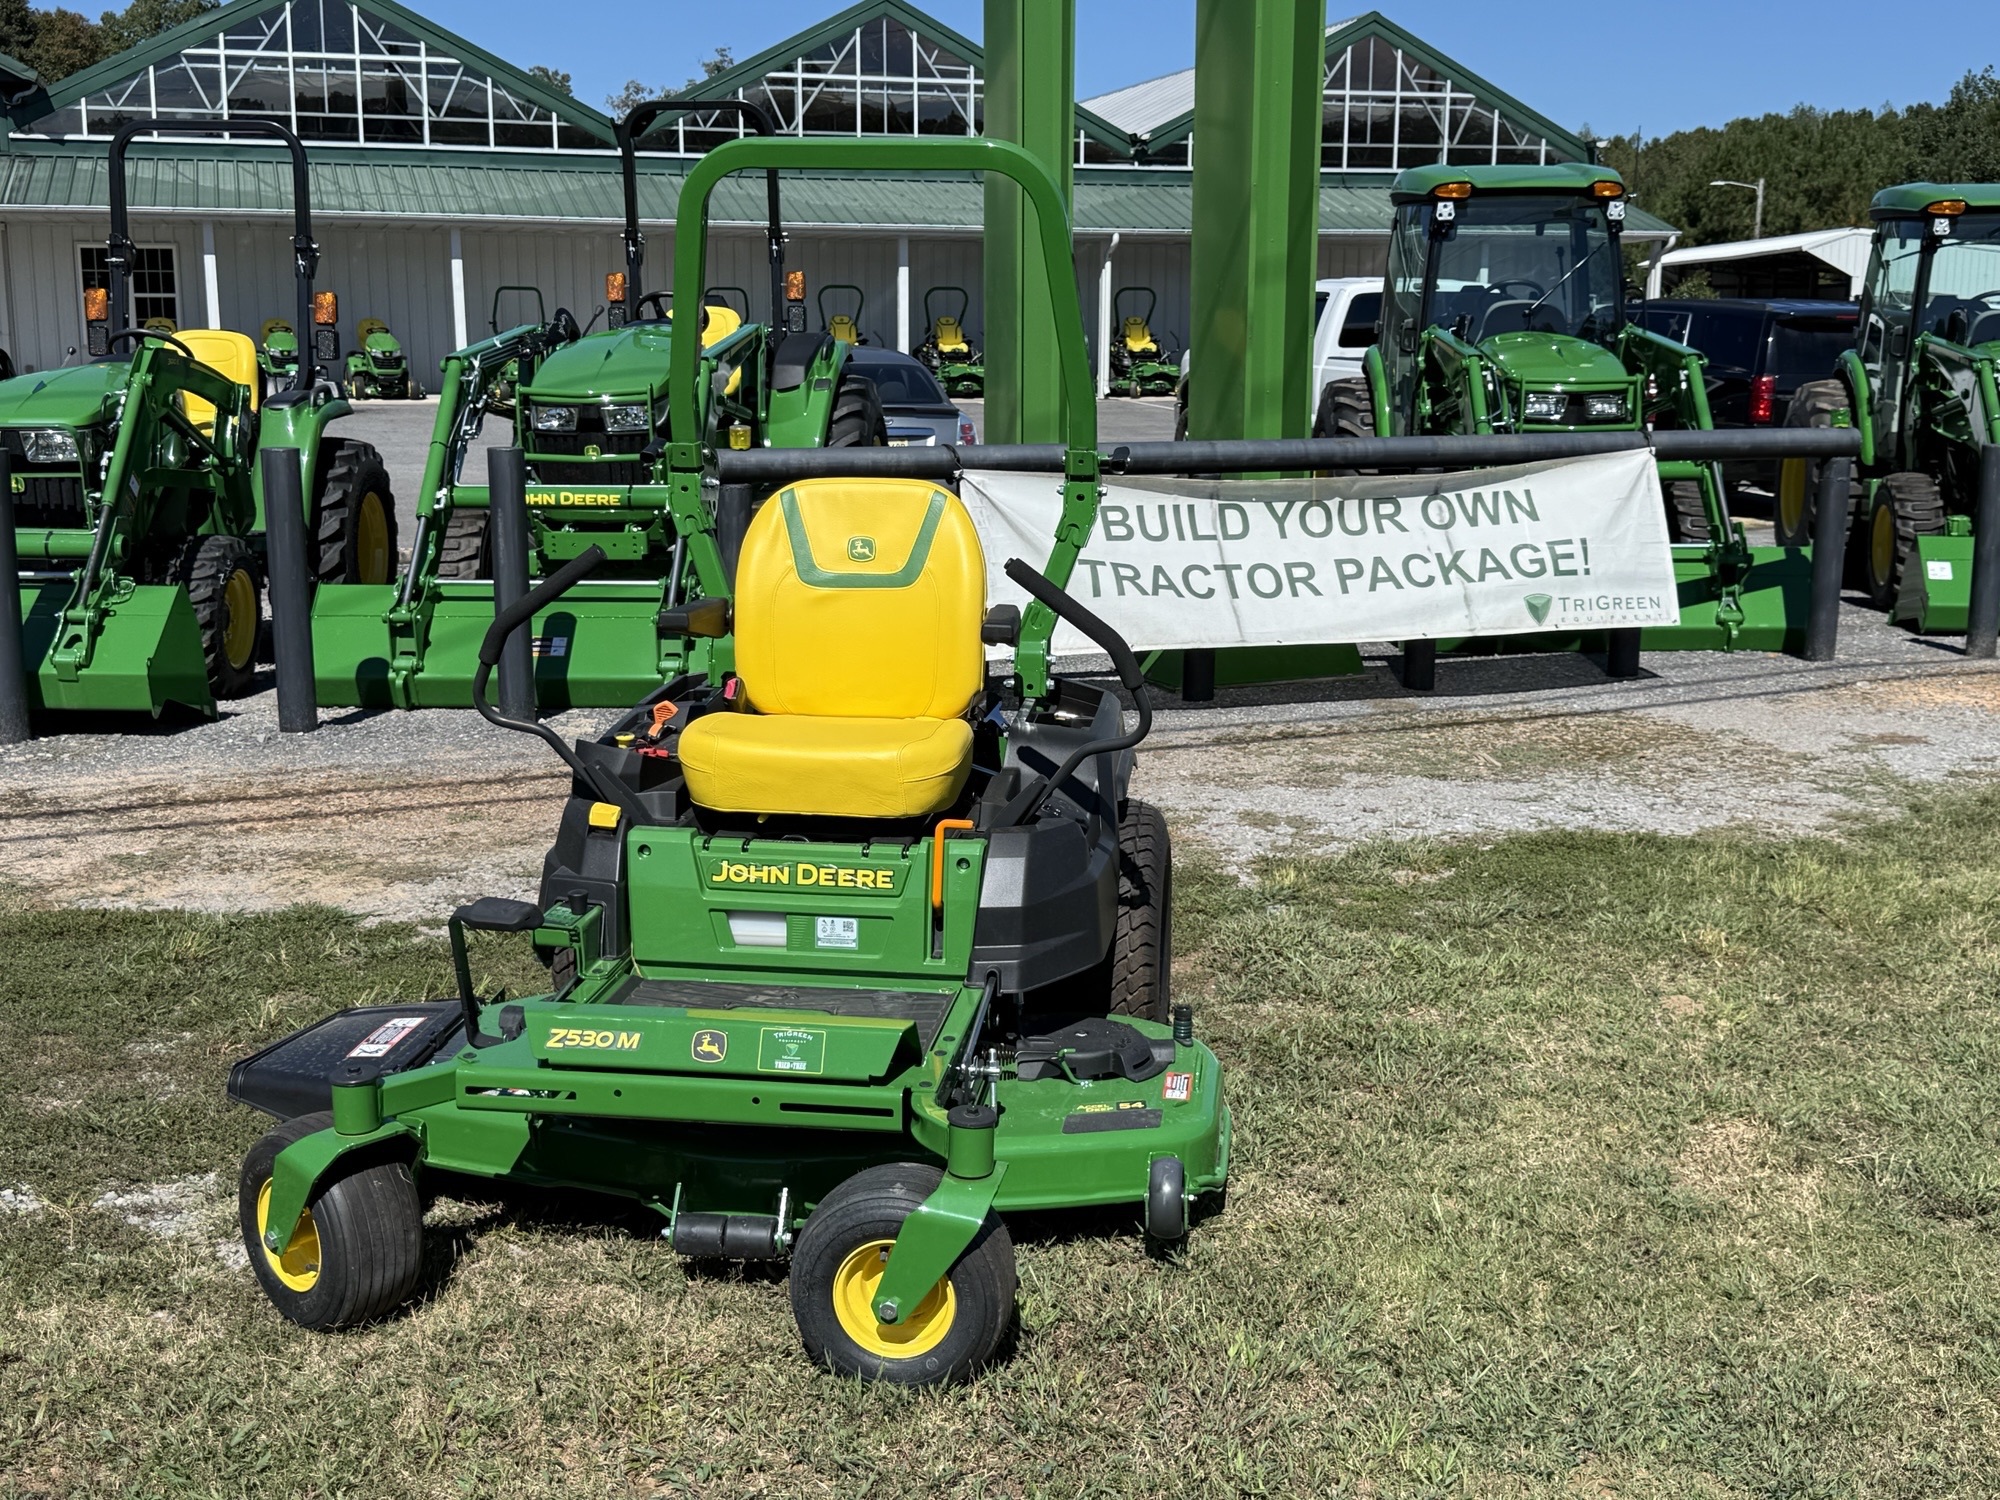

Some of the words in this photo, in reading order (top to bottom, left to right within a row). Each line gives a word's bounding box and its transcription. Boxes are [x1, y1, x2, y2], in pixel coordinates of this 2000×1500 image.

[560, 491, 621, 506] DEERE
[1100, 503, 1250, 542] BUILD
[1263, 498, 1410, 539] YOUR
[1421, 489, 1541, 530] OWN
[1078, 559, 1324, 600] TRACTOR
[1334, 537, 1591, 595] PACKAGE!
[1558, 595, 1661, 612] TRIGREEN
[1561, 613, 1664, 623] EQUIPMENT
[712, 860, 790, 885] JOHN
[796, 863, 894, 889] DEERE
[545, 1028, 615, 1048] Z530
[617, 1032, 641, 1049] M
[773, 1030, 813, 1041] TRIGREEN
[1119, 1101, 1145, 1110] 54
